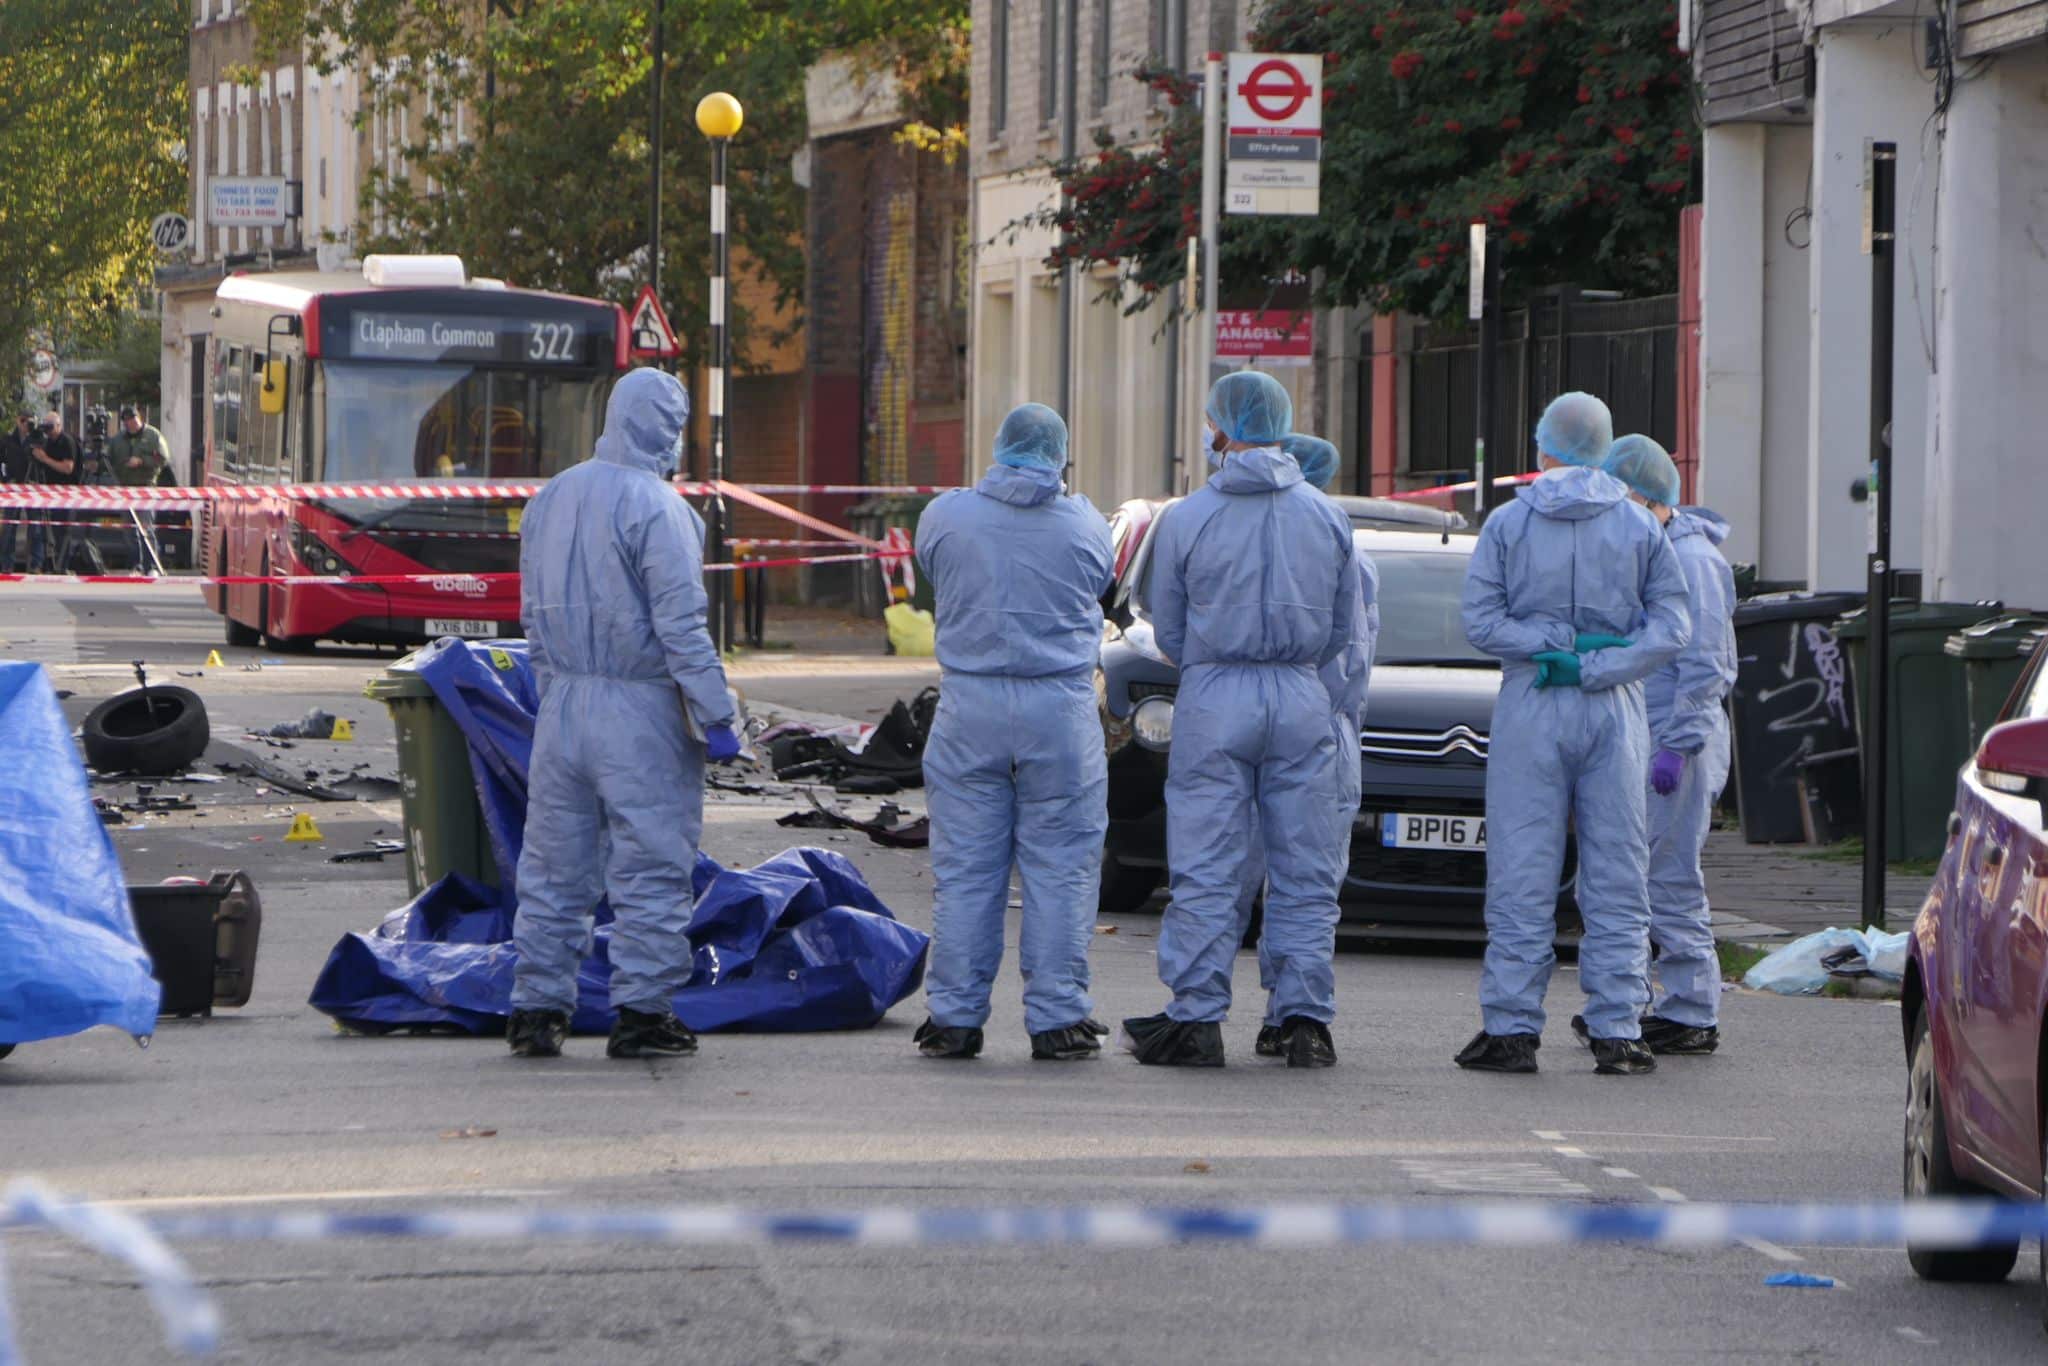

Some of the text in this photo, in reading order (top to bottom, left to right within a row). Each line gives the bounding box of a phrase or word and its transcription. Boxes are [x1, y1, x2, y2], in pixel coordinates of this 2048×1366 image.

[254, 185, 279, 194] FOOD
[1216, 312, 1236, 324] ET
[359, 317, 574, 361] Clapham Common 322
[1406, 816, 1467, 844] BP16
